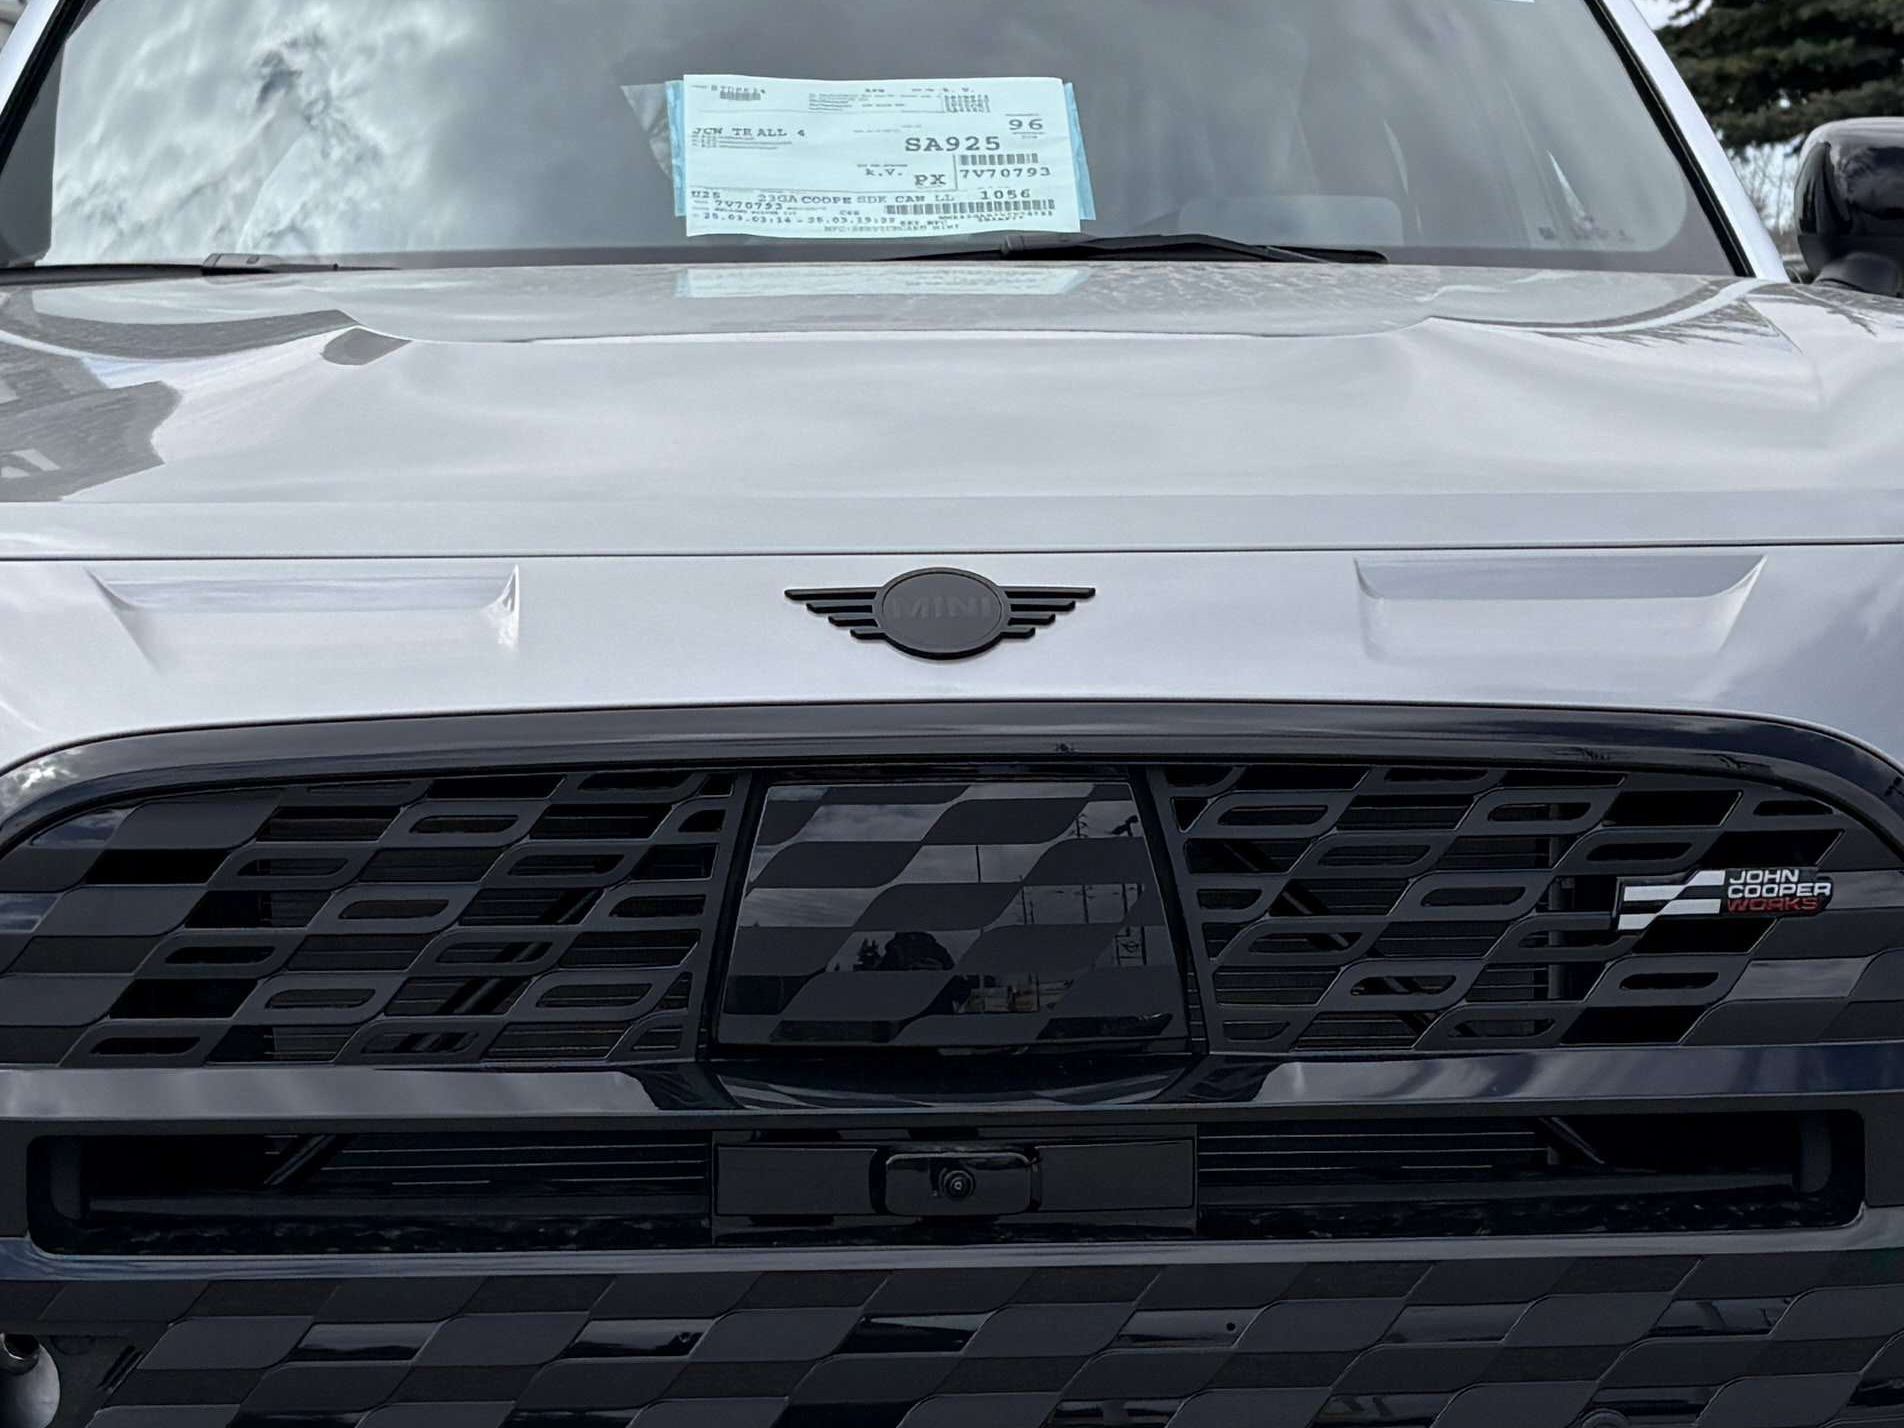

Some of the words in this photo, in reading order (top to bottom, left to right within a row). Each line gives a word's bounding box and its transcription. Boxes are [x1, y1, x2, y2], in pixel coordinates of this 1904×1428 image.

[1009, 118, 1044, 131] 96
[905, 136, 1001, 152] SA925
[914, 173, 946, 186] PX
[959, 166, 1051, 179] 7V70793
[891, 596, 990, 620] MINI
[1729, 869, 1799, 884] JOHN
[1727, 883, 1832, 899] COOPER
[1726, 898, 1819, 912] WORKS
